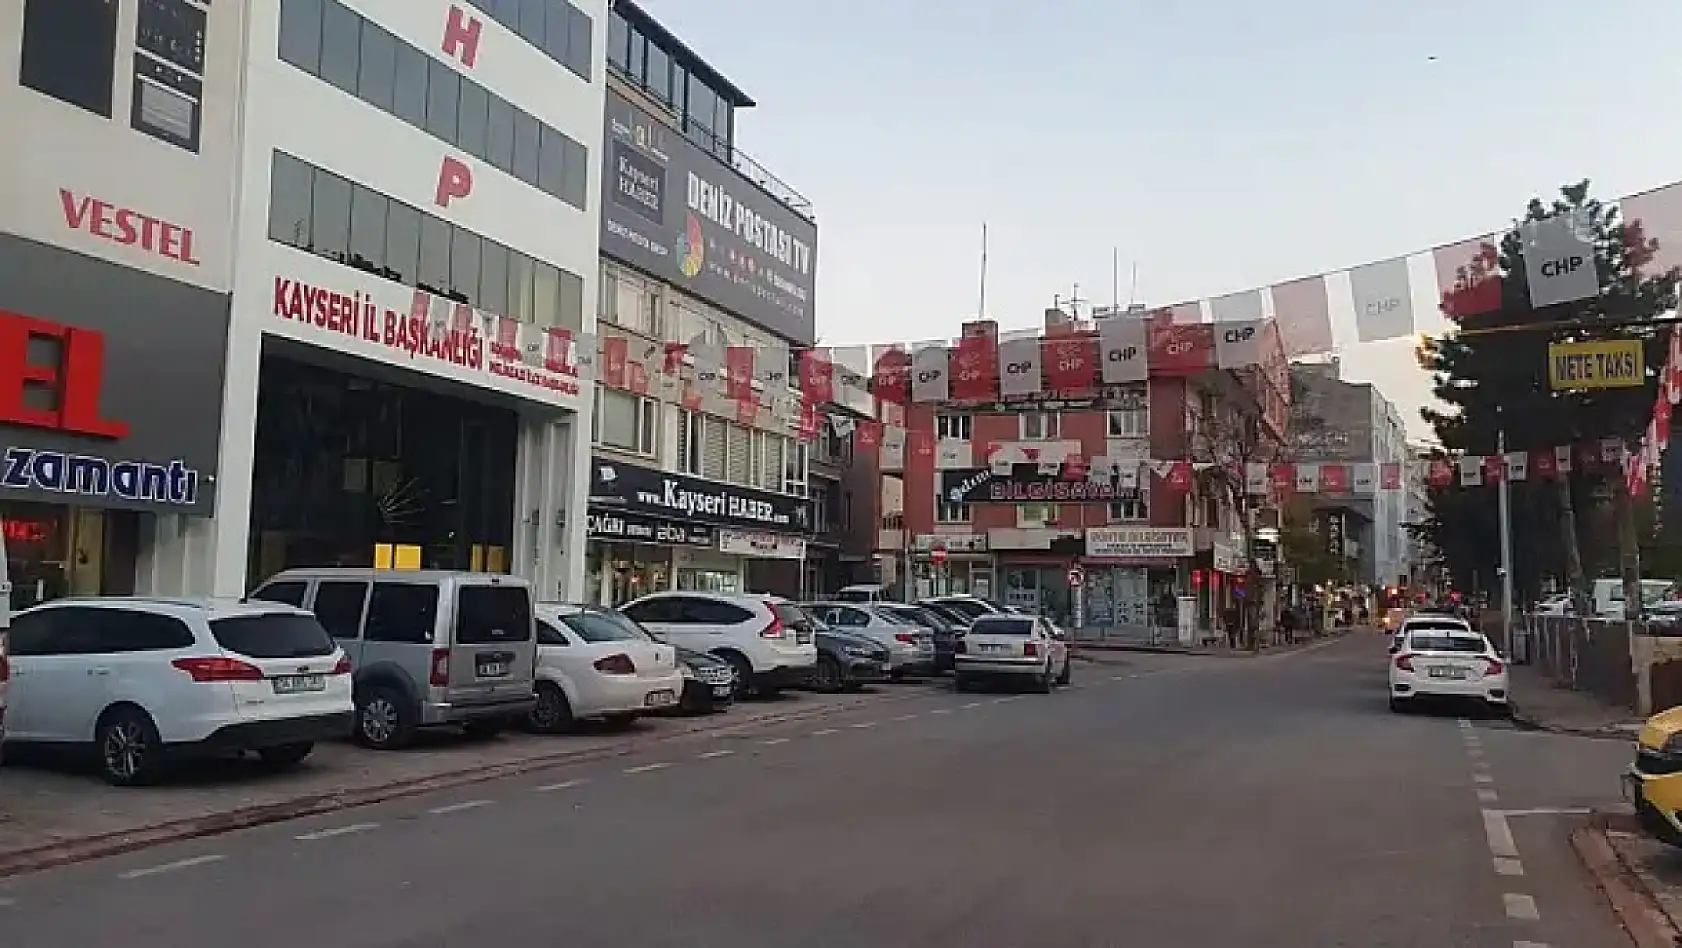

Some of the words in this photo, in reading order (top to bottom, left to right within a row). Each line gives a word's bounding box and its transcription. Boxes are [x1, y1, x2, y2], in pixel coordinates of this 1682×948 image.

[441, 4, 483, 69] H
[434, 155, 473, 208] P
[59, 187, 200, 266] VESTEL
[688, 170, 732, 230] DENİZ
[736, 202, 791, 266] POSTASI
[792, 238, 811, 274] TV
[1540, 255, 1584, 278] CHP
[274, 275, 360, 337] KAYSERİ
[362, 294, 381, 343] İL
[1224, 326, 1256, 343] CHP
[1058, 358, 1085, 371] CHP
[1109, 346, 1137, 362] CHP
[1166, 342, 1194, 355] CHP
[1, 447, 198, 503] zamantı
